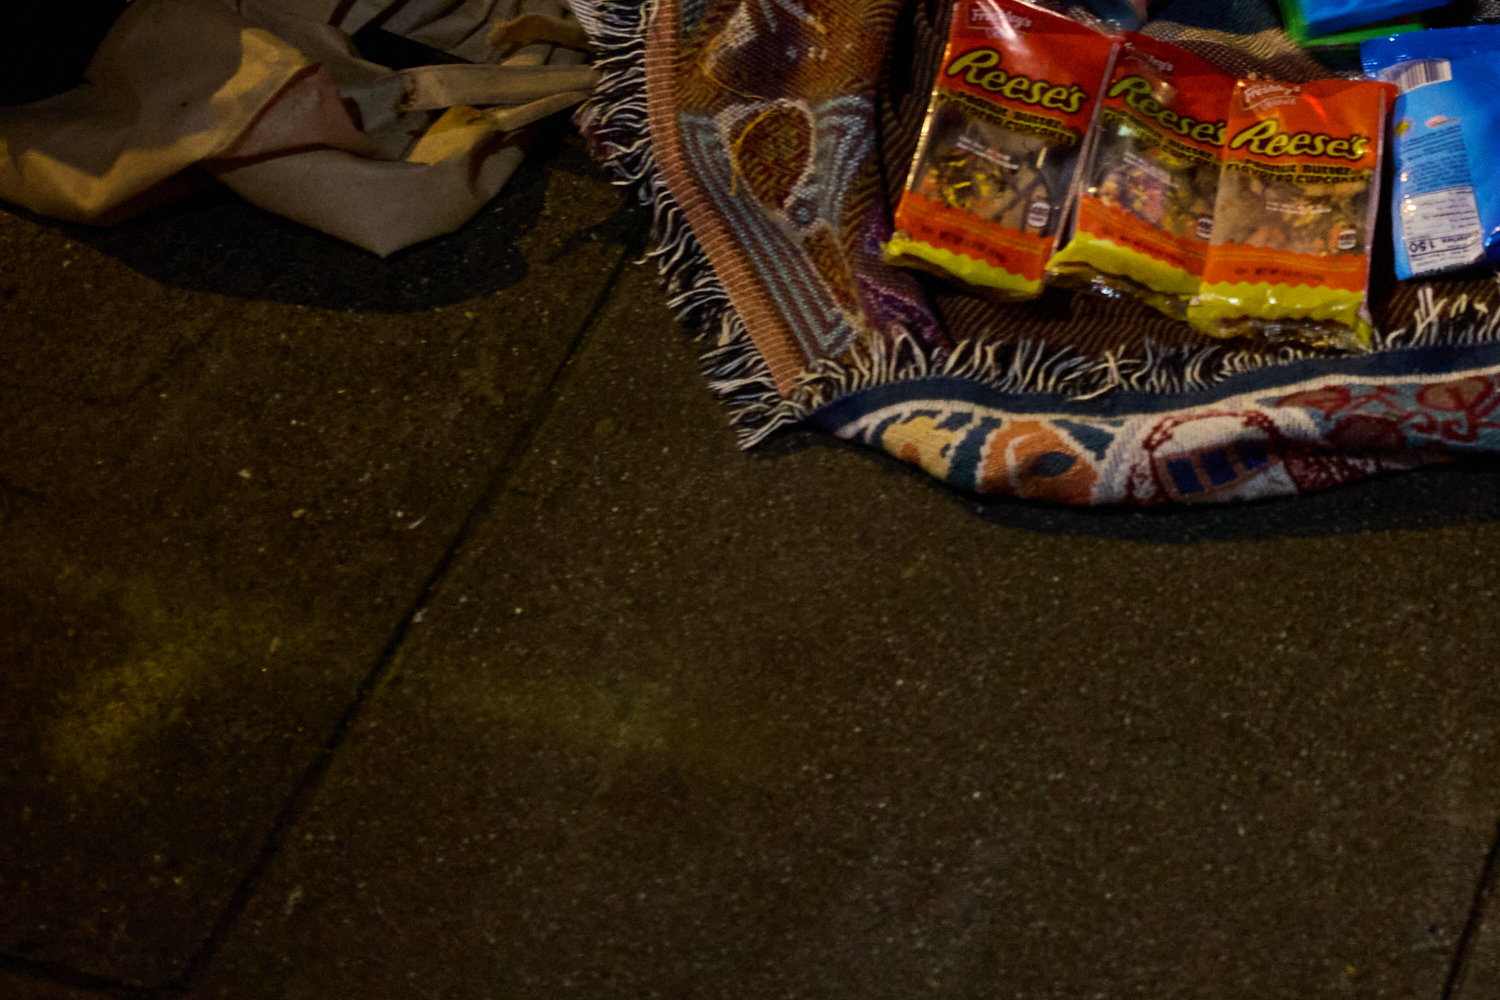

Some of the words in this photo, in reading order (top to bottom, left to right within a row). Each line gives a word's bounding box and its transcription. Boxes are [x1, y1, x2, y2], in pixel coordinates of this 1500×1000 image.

[946, 49, 1087, 113] Reese's
[1108, 76, 1226, 146] Reese's
[1229, 119, 1370, 161] Reese's
[1408, 238, 1435, 253] 150
